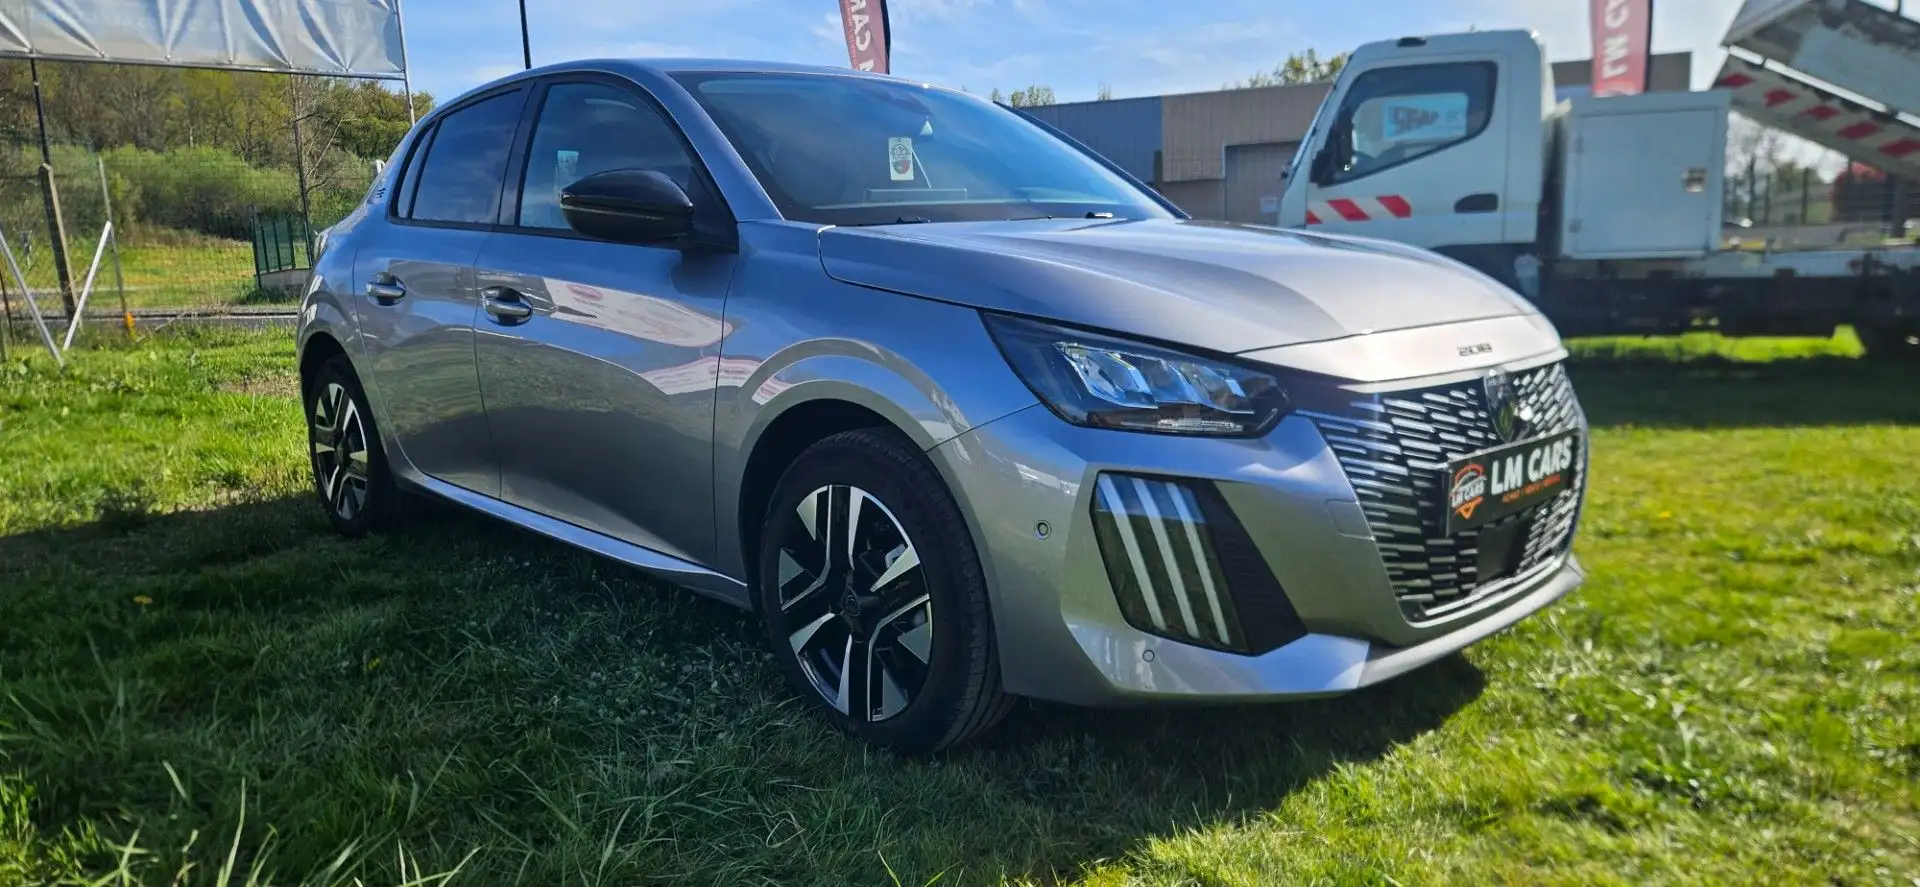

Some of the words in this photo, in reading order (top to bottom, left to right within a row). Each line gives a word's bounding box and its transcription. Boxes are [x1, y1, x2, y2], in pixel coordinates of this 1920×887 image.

[1457, 343, 1492, 356] 208
[1491, 453, 1523, 495] LM
[1528, 436, 1573, 482] CARS
